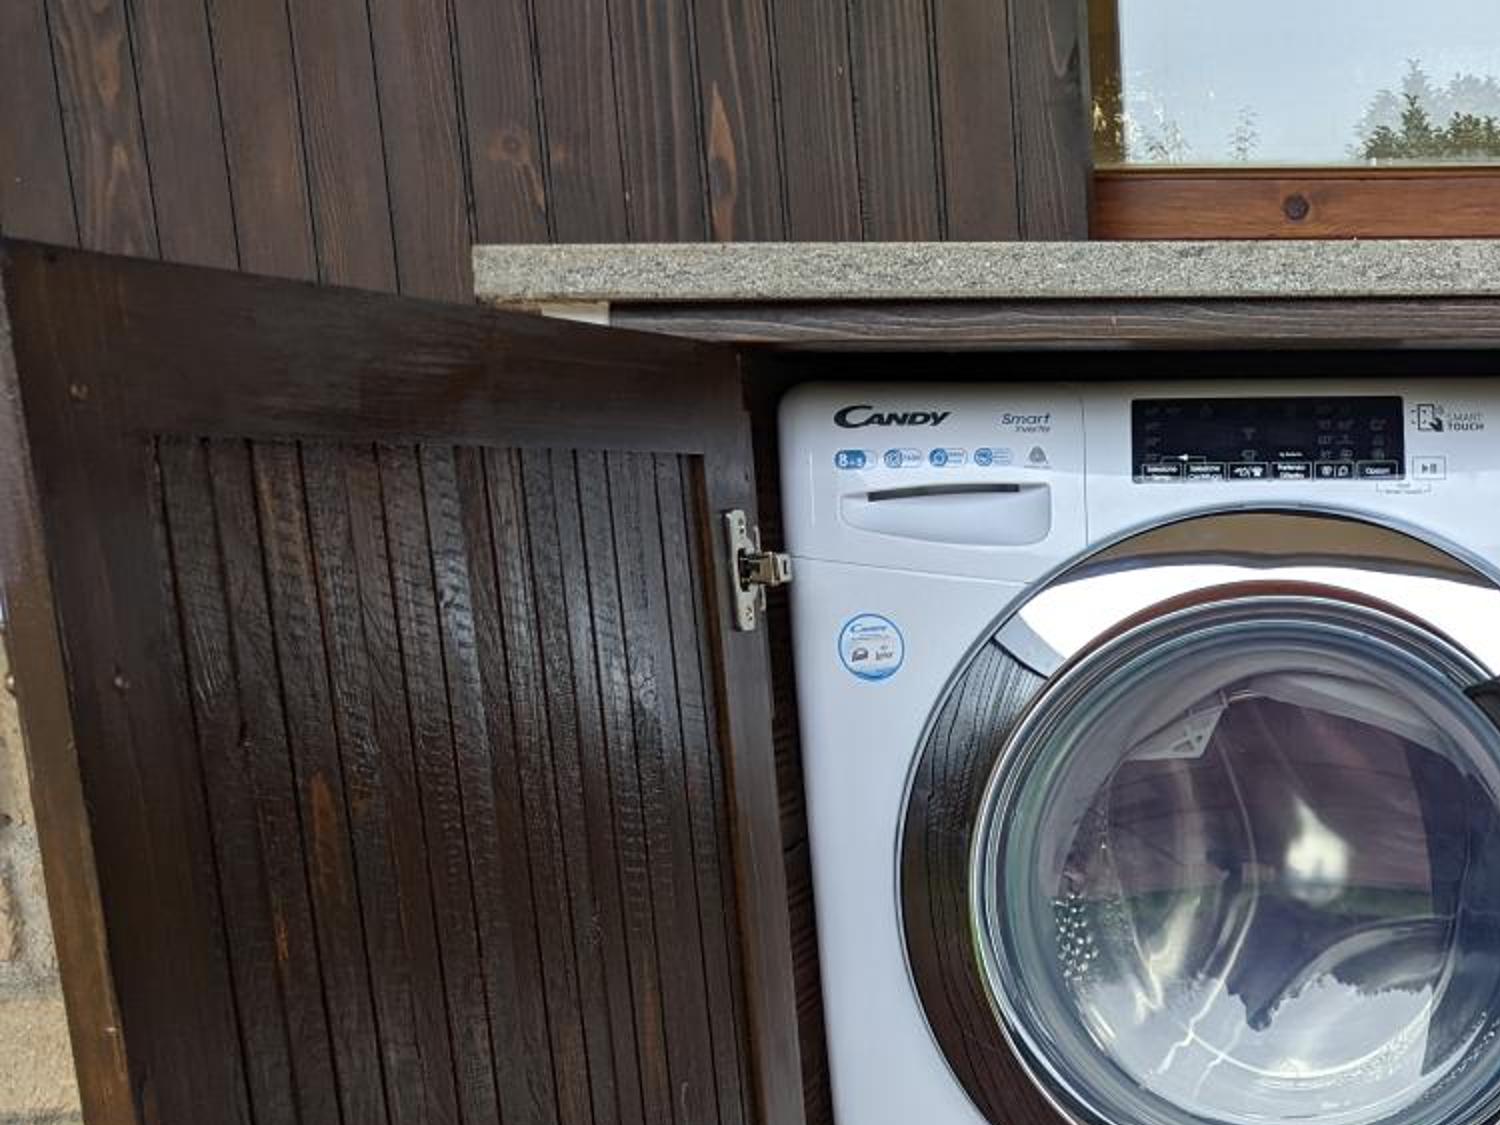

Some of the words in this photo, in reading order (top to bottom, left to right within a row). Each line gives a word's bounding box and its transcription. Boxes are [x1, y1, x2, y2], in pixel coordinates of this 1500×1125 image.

[833, 405, 952, 428] CANDY
[1002, 412, 1051, 425] Smart
[1447, 422, 1485, 431] TOUCH
